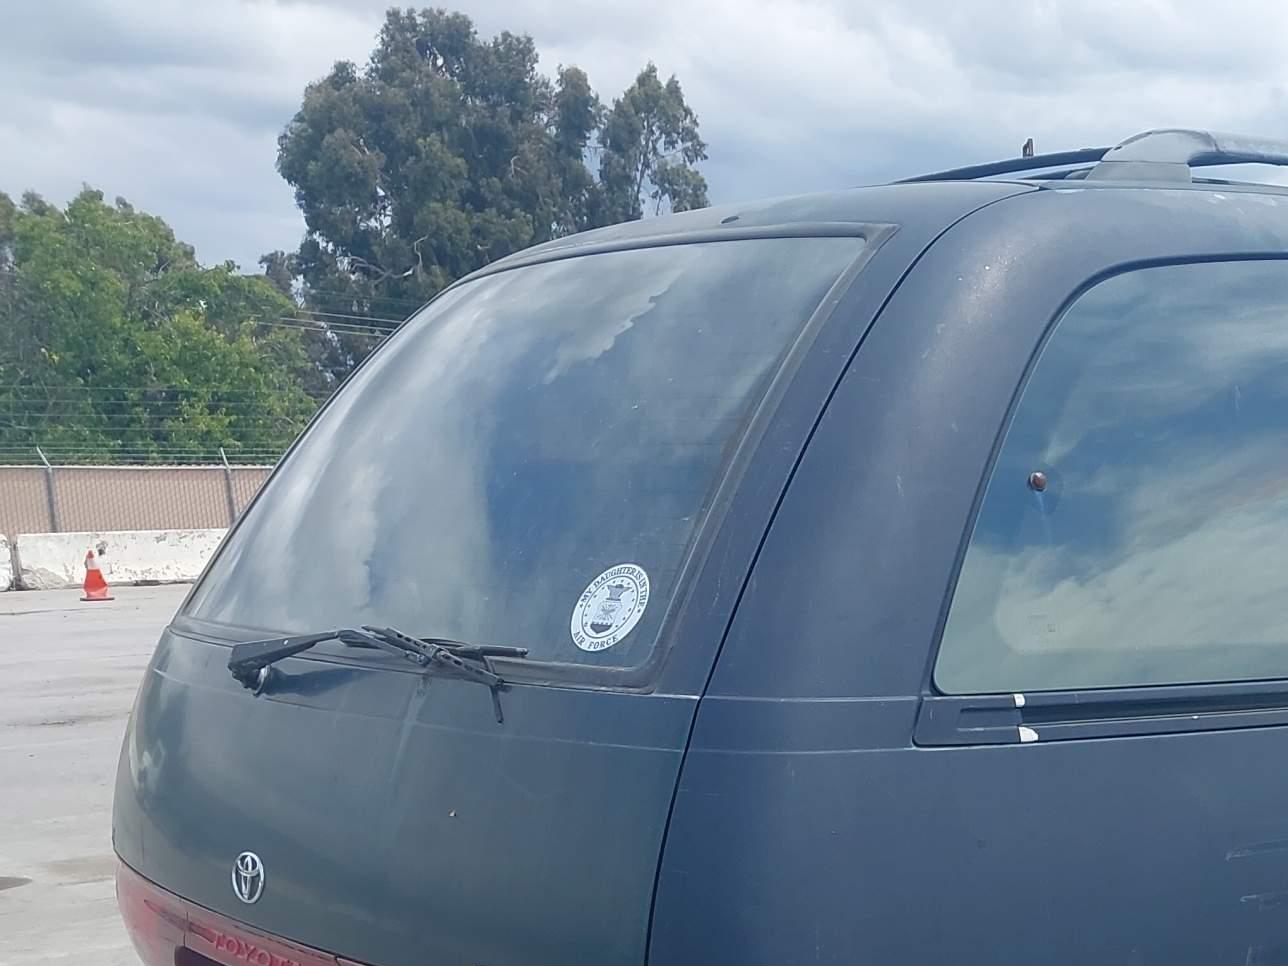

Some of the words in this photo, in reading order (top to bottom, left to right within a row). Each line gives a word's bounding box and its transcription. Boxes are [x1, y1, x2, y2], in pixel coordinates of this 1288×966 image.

[580, 588, 592, 603] MY
[594, 566, 637, 588] DAUGHTER
[634, 570, 644, 581] IS
[639, 588, 648, 608] THE
[573, 631, 585, 646] AIR
[588, 634, 619, 649] FORCE
